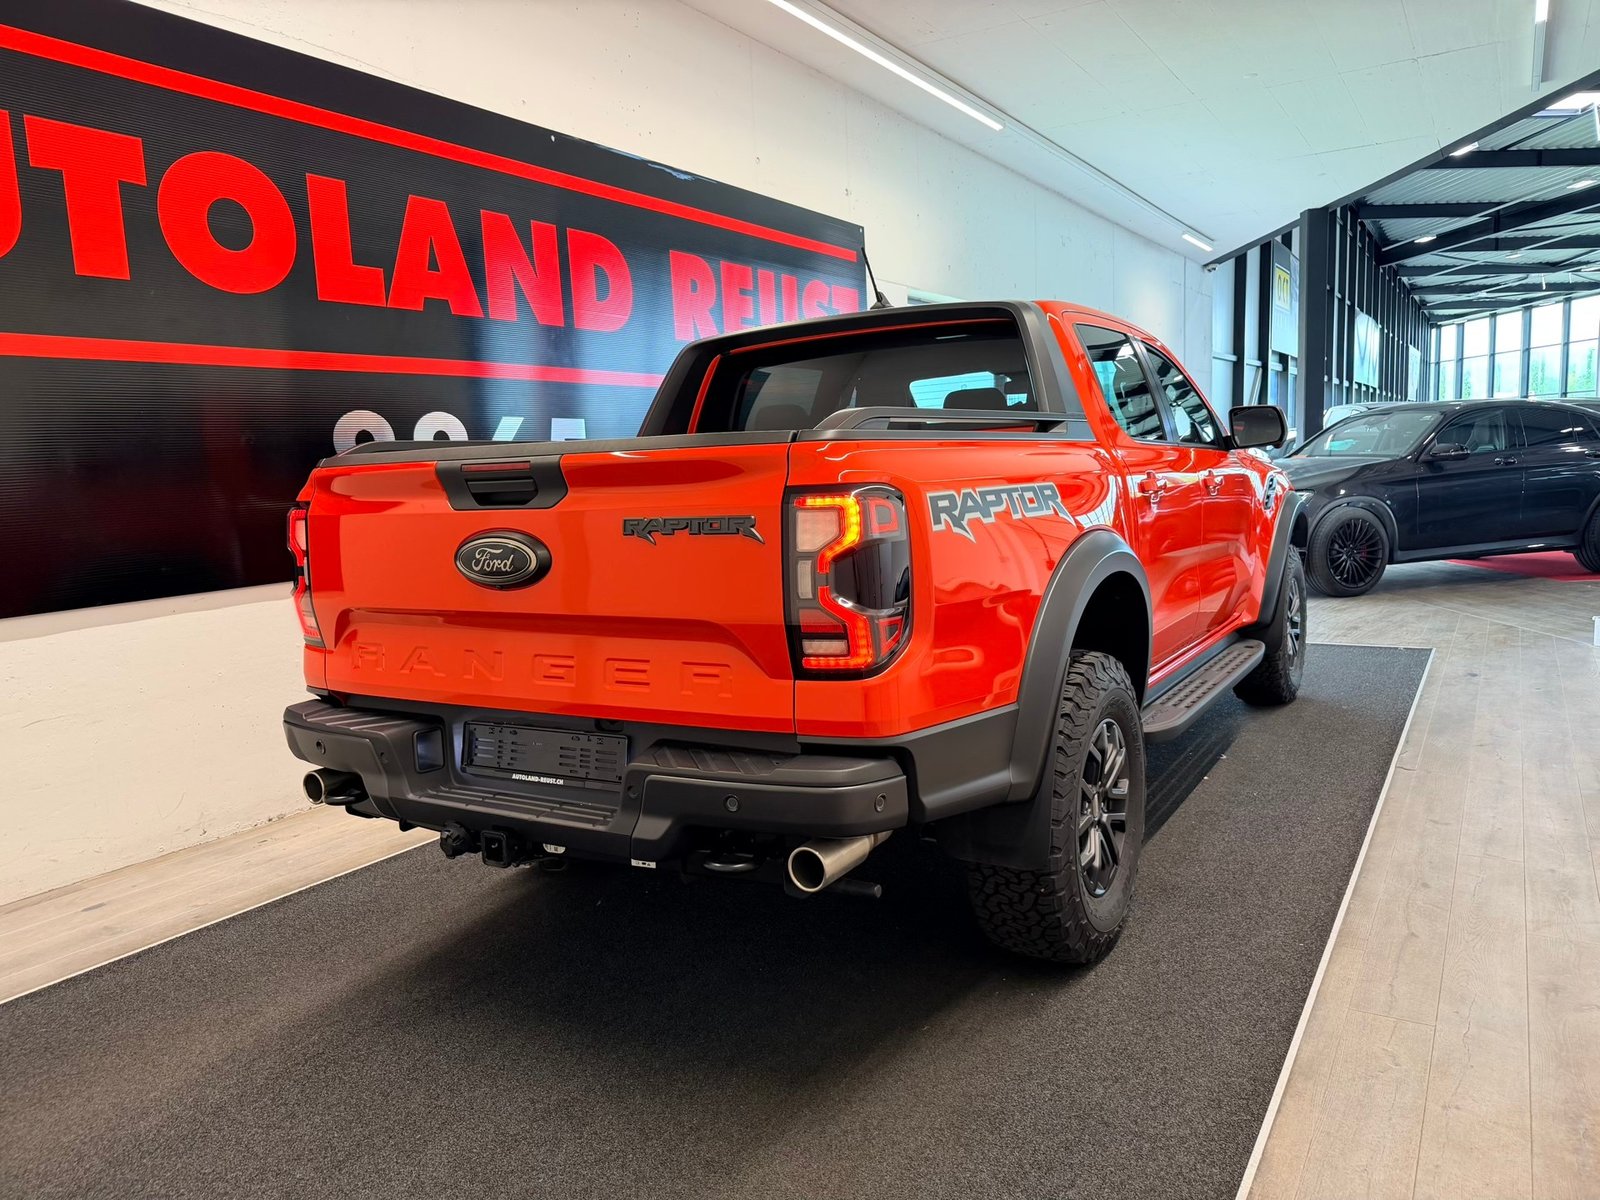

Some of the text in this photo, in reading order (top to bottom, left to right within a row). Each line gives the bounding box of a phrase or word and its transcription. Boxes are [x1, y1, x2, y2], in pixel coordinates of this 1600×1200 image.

[0, 109, 633, 333] TOLAND
[623, 515, 765, 545] RAPTOR
[926, 482, 1077, 543] RAPTOR
[472, 547, 515, 573] Ford
[351, 641, 733, 698] RANGER
[512, 773, 564, 786] AUTOLAND-REUST.CH
